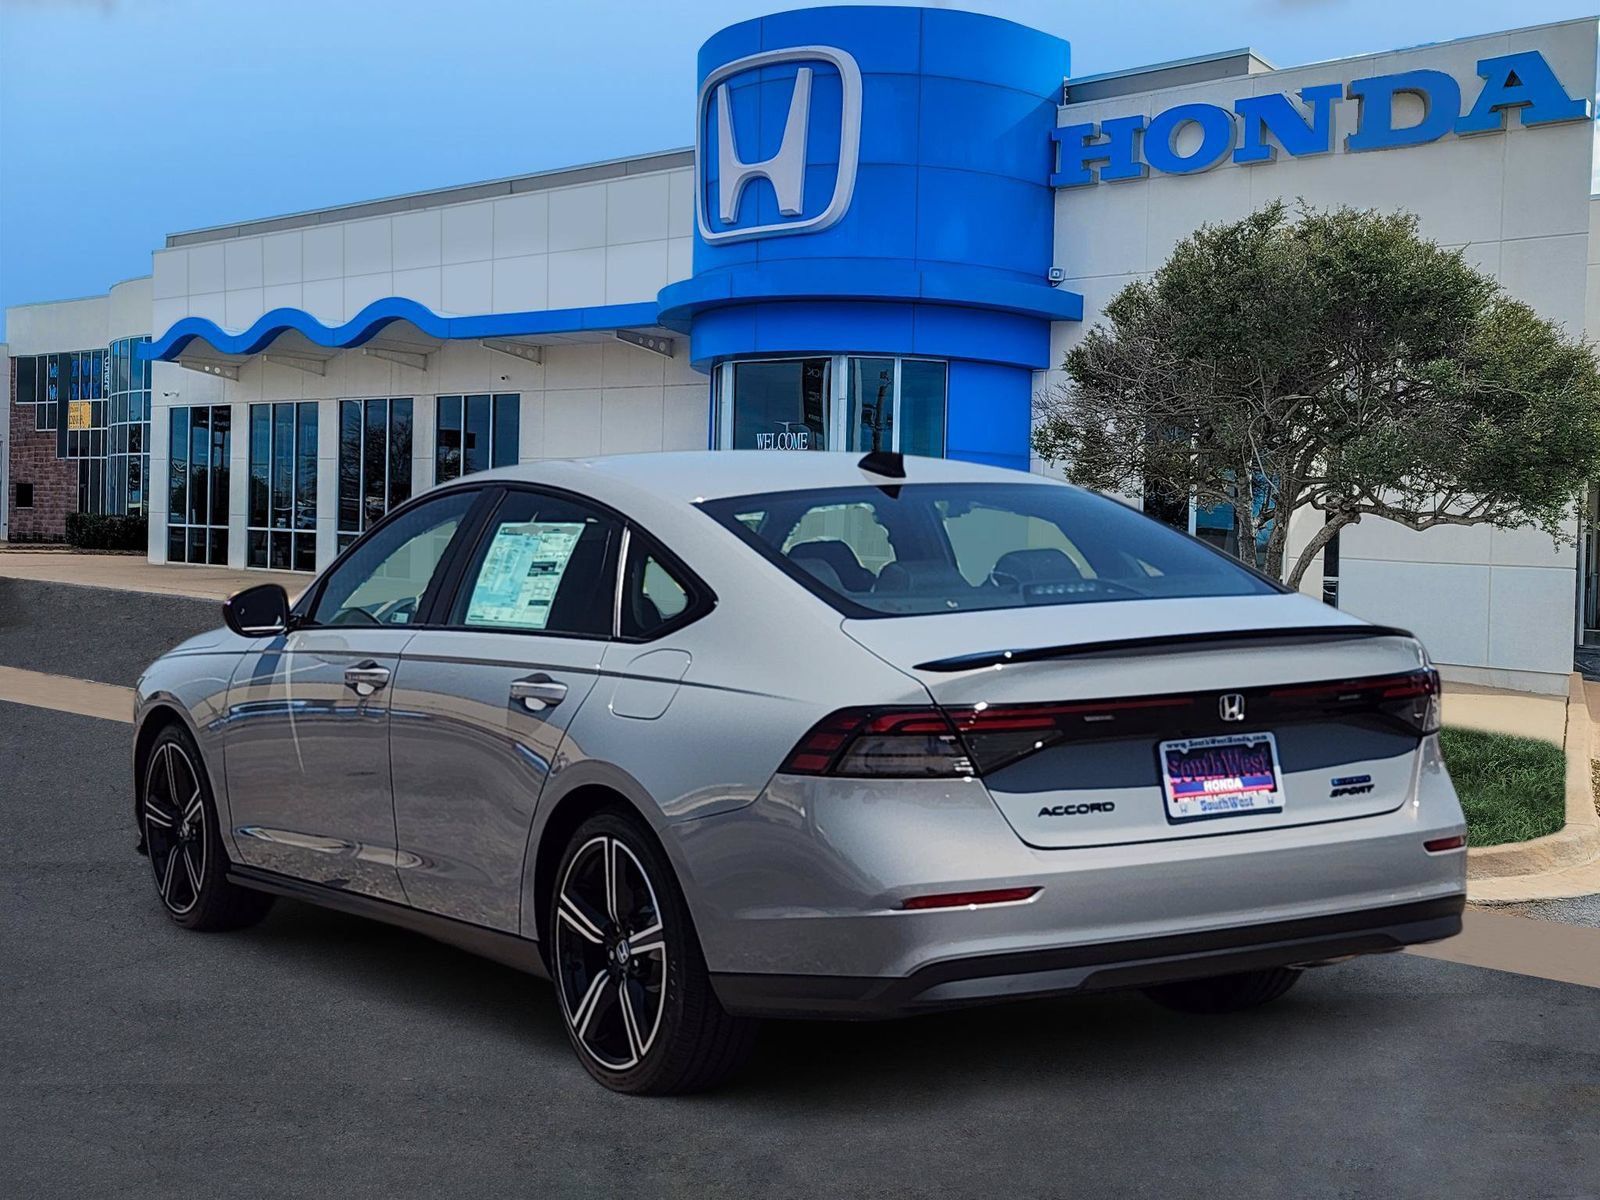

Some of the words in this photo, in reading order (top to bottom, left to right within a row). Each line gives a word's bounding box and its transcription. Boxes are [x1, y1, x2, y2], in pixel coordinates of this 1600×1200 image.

[1050, 50, 1591, 188] HONDA
[756, 432, 809, 451] WELCOME
[1203, 777, 1244, 793] HONDA
[1329, 784, 1375, 798] SPORT
[1038, 801, 1115, 817] ACCORD
[1200, 796, 1255, 812] SouthWest
